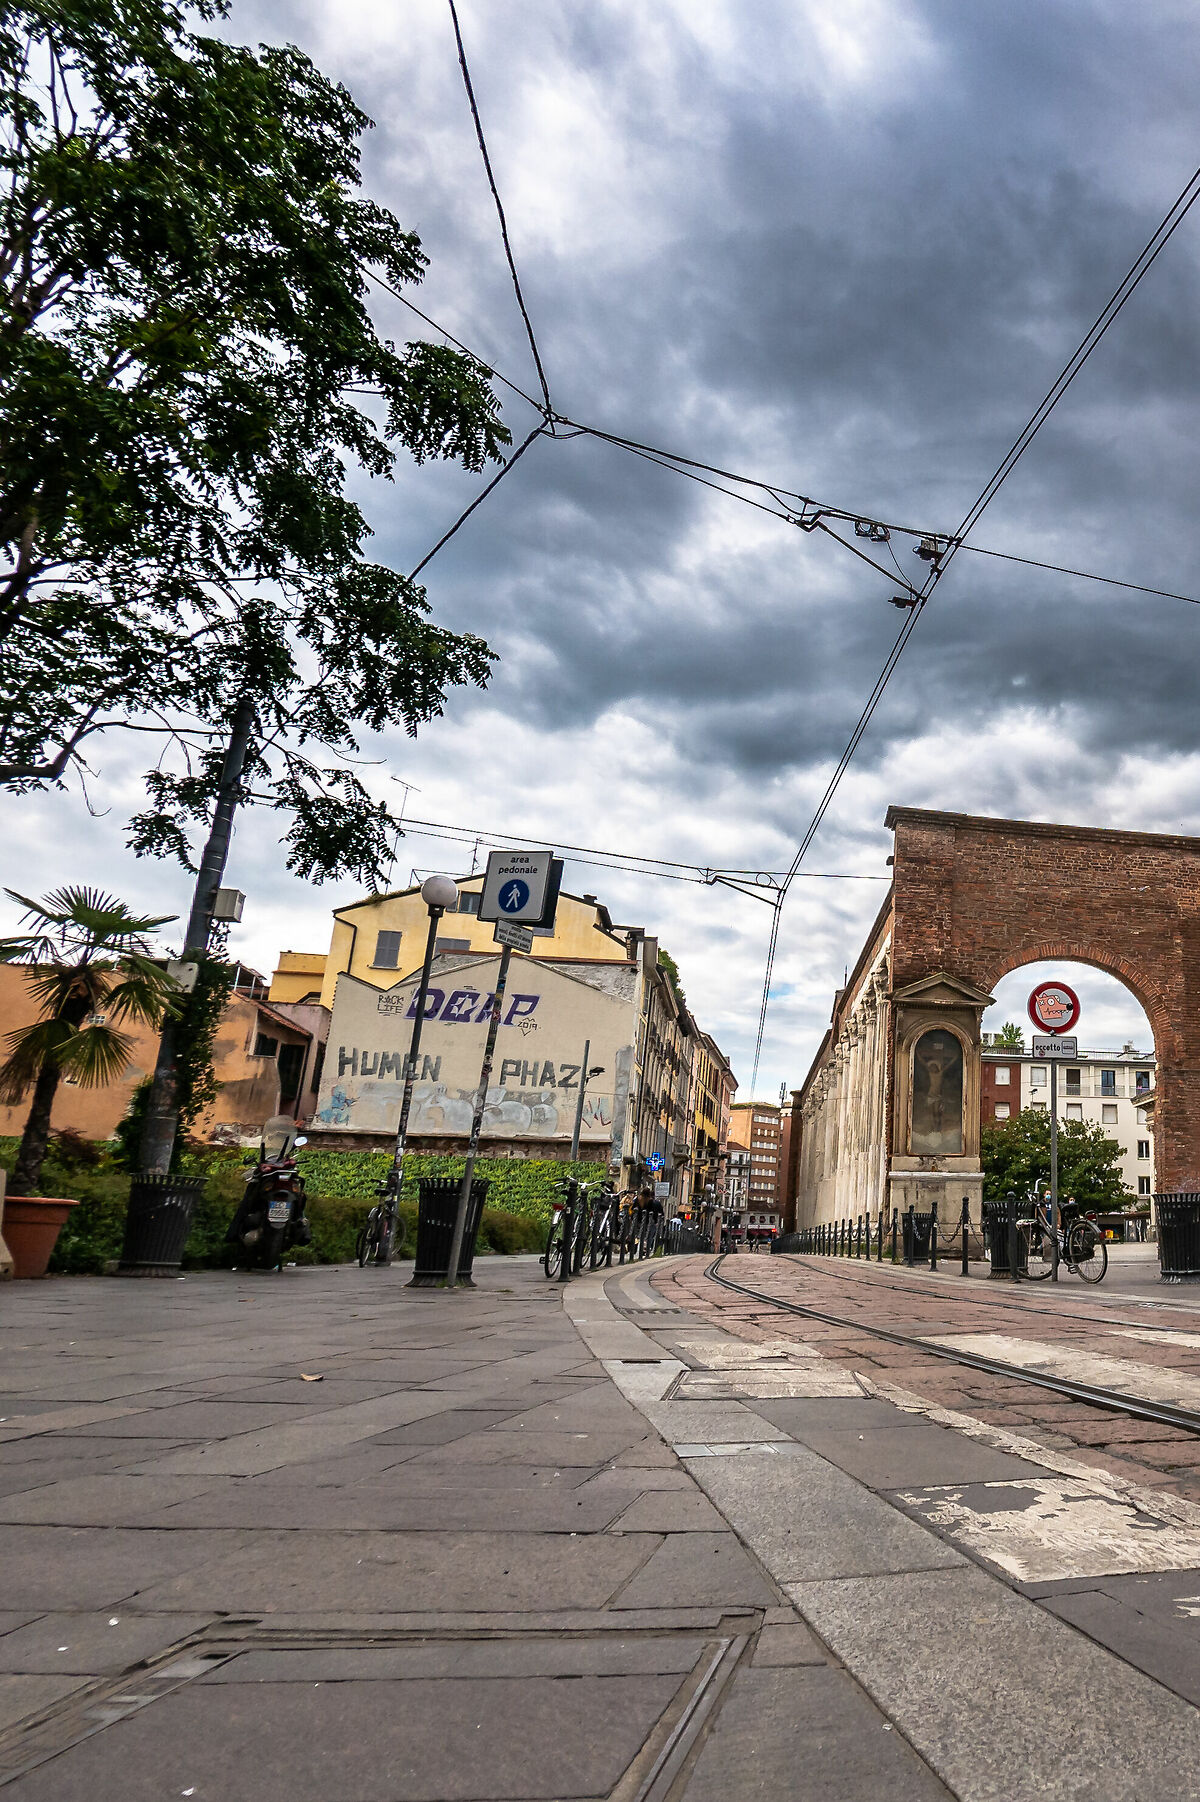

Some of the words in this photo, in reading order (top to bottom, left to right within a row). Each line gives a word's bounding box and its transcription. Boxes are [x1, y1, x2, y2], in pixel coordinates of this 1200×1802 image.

[510, 856, 530, 864] area
[498, 865, 538, 875] pedonale
[1035, 1043, 1061, 1052] eccetto
[499, 1058, 582, 1088] PHAZ
